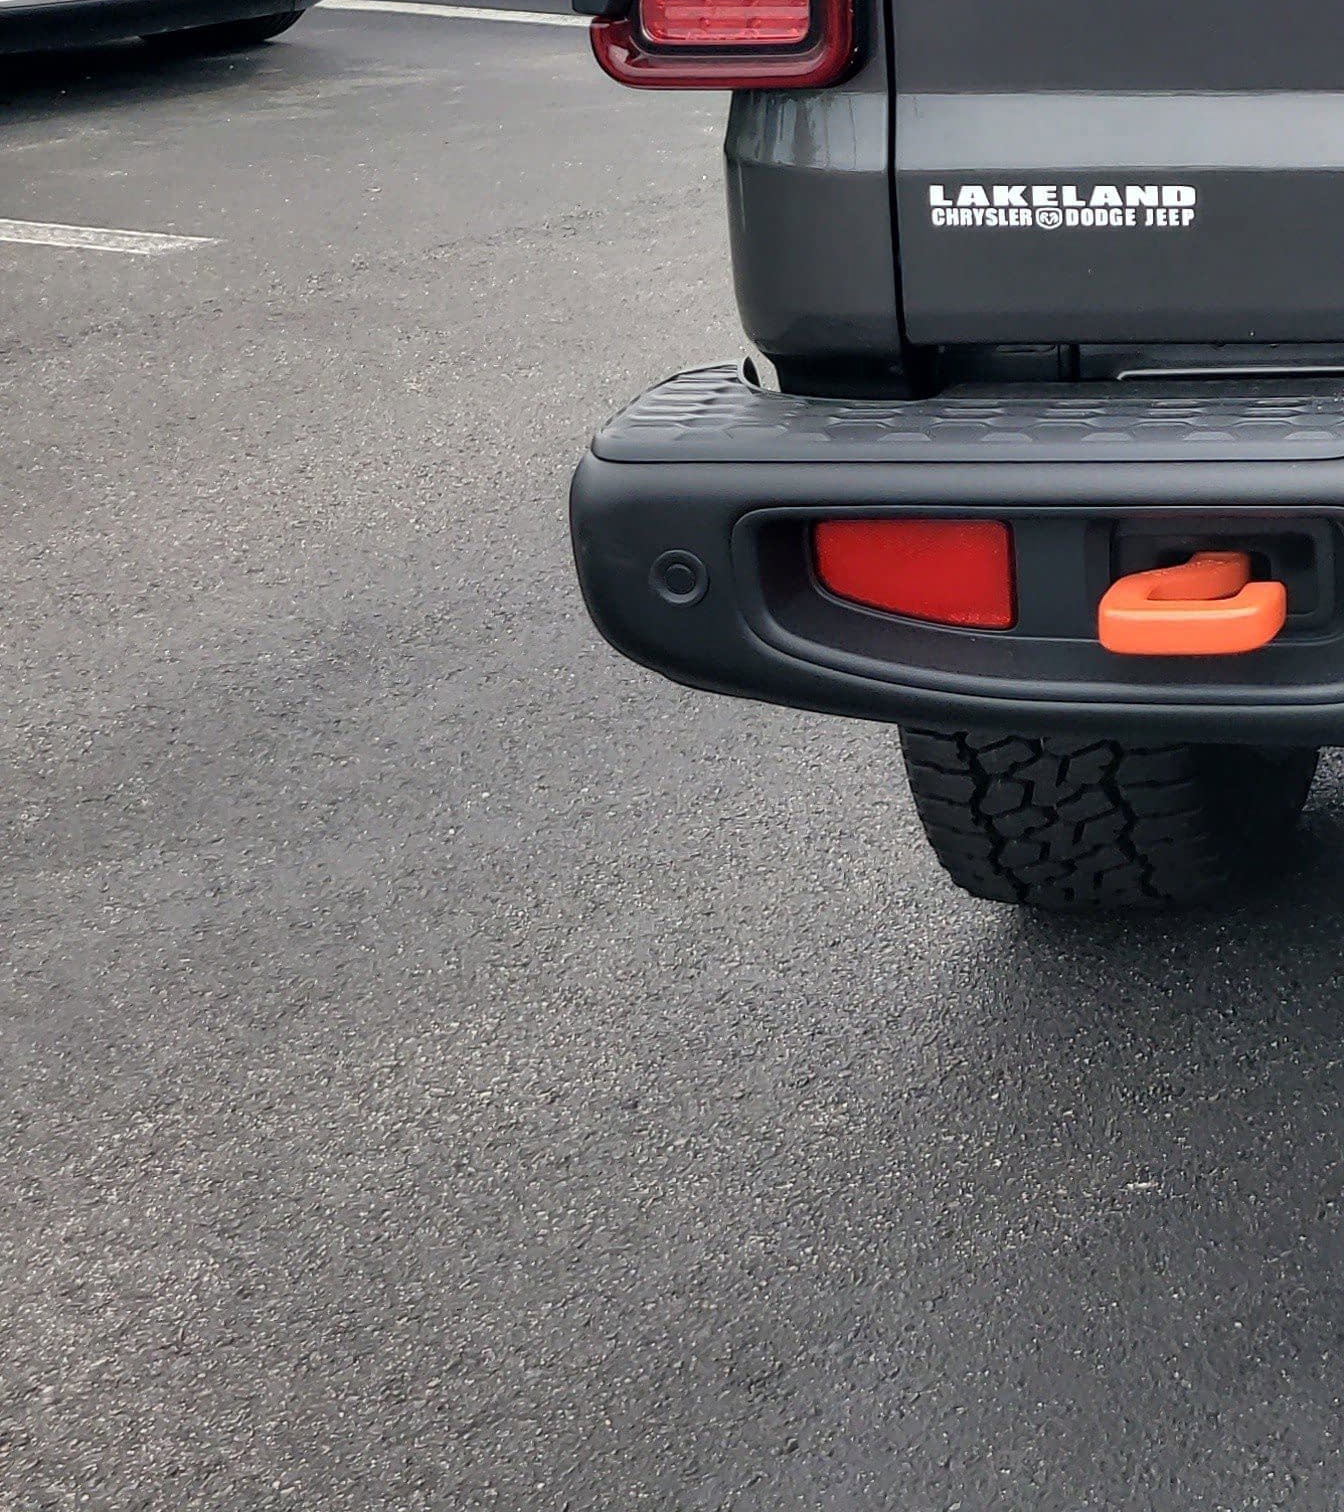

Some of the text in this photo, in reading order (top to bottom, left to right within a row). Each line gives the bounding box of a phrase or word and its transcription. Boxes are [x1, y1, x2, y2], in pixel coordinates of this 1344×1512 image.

[929, 185, 1197, 207] LAKELAND
[931, 207, 1196, 227] CHRYSLER DODGE JEEP
